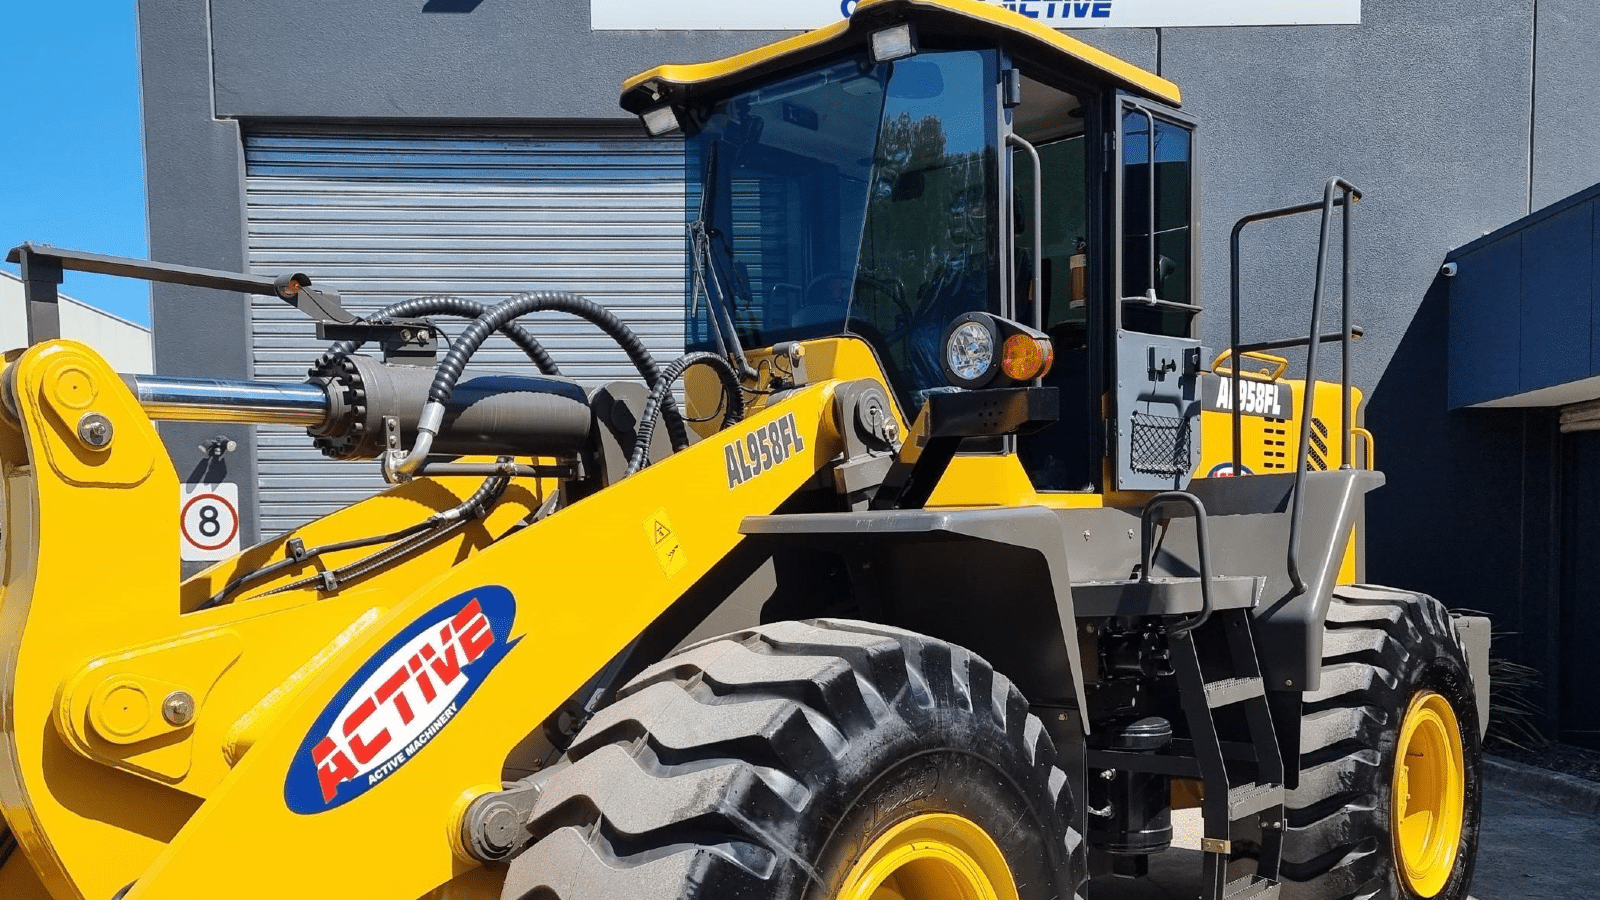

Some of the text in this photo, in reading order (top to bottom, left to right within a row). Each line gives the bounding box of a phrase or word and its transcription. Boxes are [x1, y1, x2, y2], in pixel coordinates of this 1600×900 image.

[724, 412, 805, 491] AL958FL
[199, 505, 220, 537] 8
[312, 597, 496, 804] ACTIVE
[368, 702, 458, 786] ACTIVE MACHINERY
